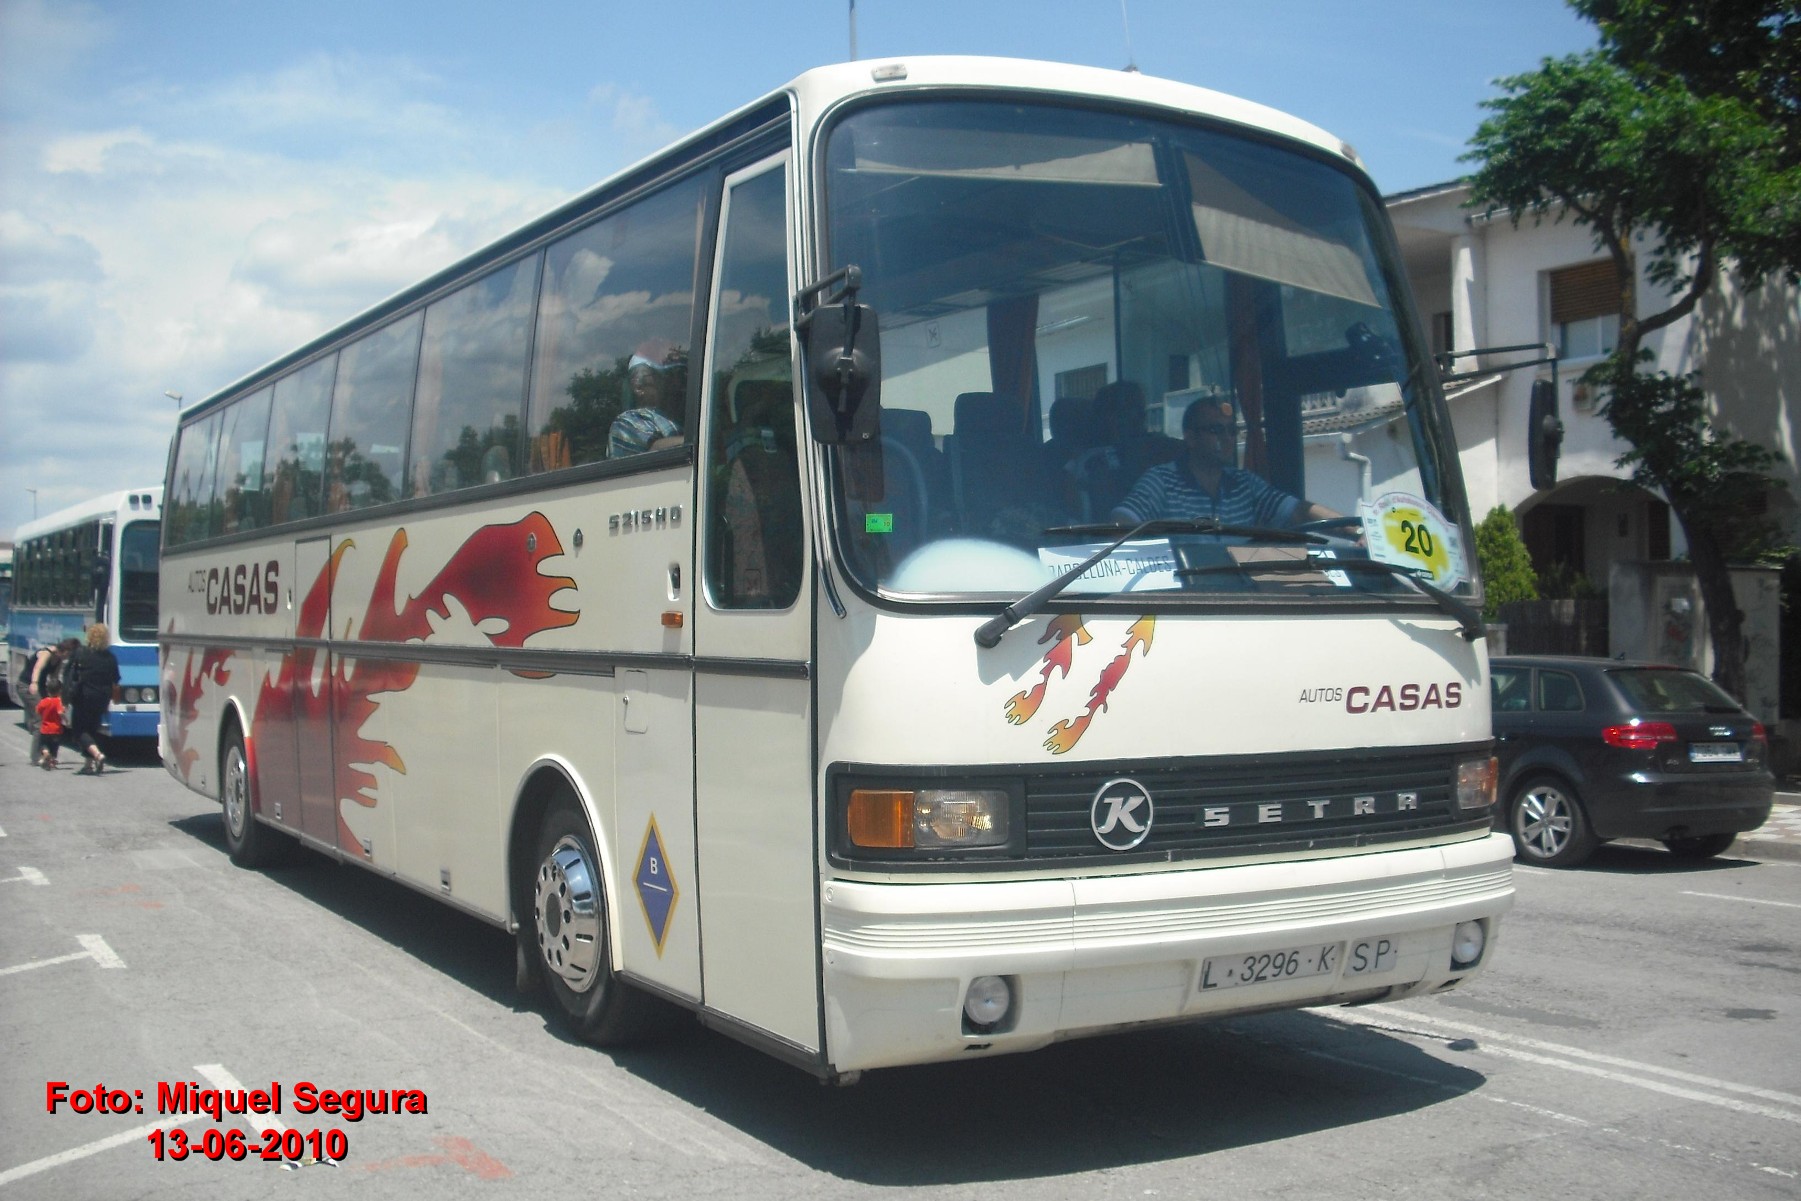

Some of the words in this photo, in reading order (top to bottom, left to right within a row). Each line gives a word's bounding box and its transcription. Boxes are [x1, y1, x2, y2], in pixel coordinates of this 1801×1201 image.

[1401, 519, 1434, 558] 20
[206, 560, 279, 615] CASAS
[1299, 687, 1343, 704] AUTOS
[1345, 681, 1462, 715] CASAS
[1203, 792, 1418, 828] SETRA
[650, 857, 658, 875] B
